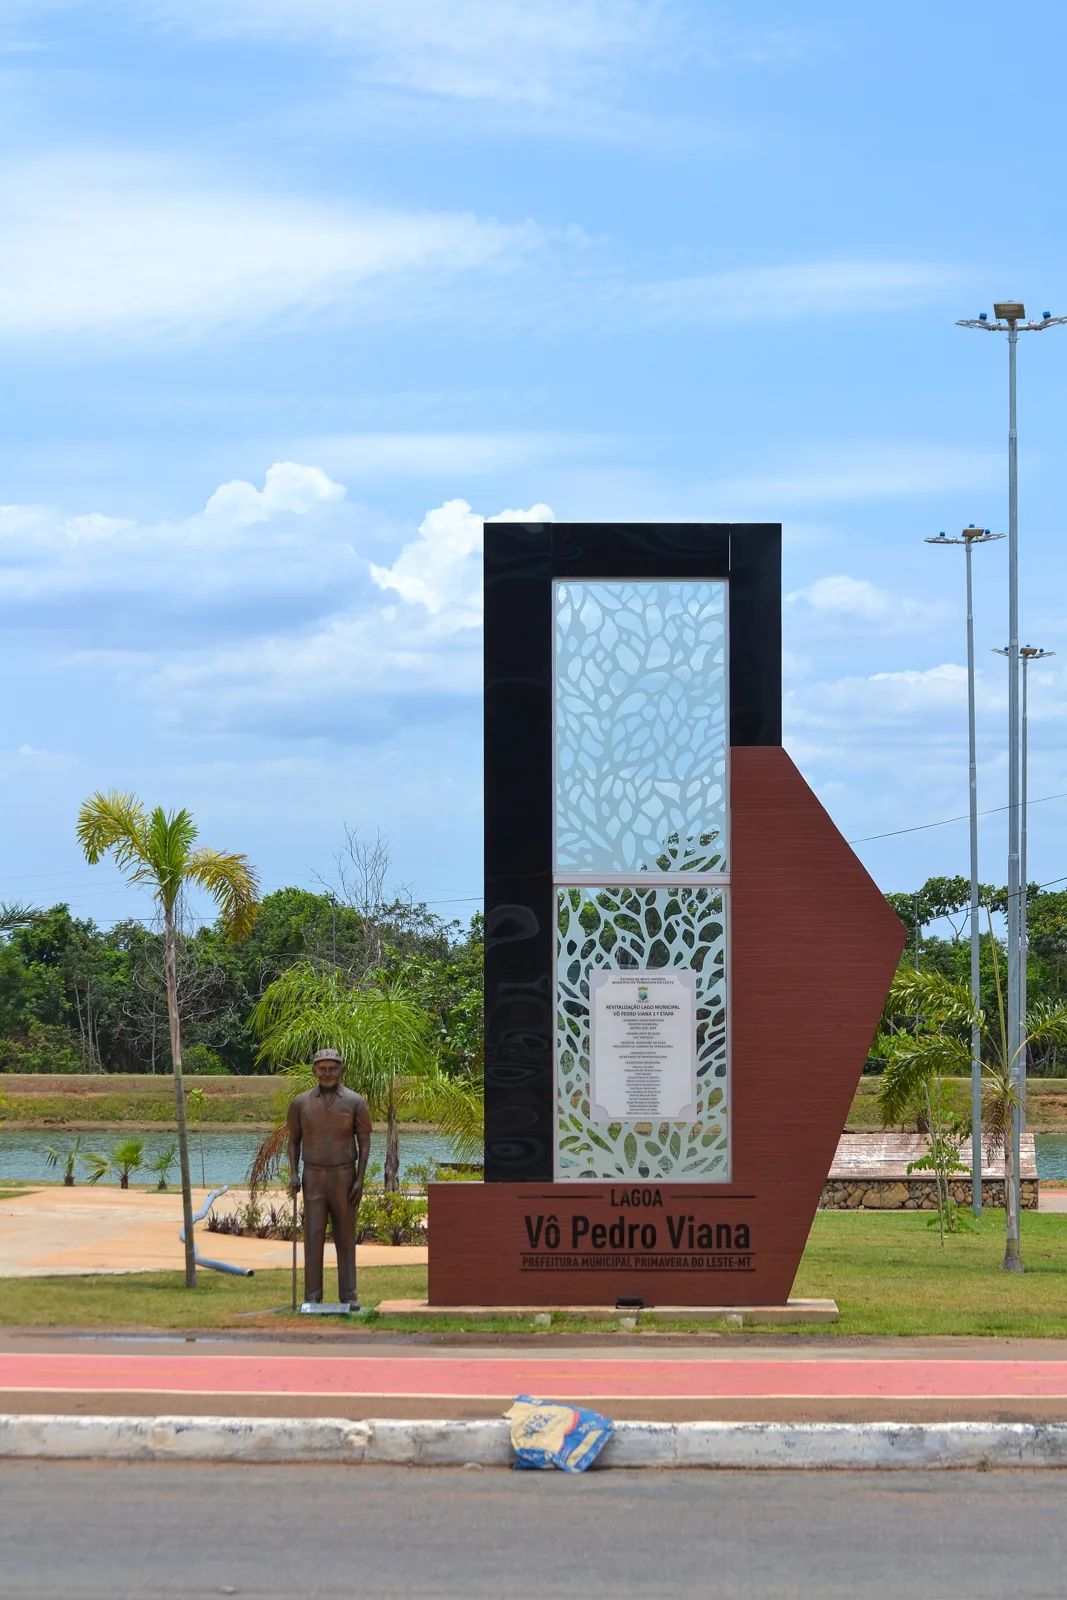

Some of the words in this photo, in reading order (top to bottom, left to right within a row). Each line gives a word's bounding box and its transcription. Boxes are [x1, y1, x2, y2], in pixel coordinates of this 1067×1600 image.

[611, 1189, 663, 1207] LAGOA
[524, 1214, 561, 1249] Vô
[571, 1215, 657, 1249] Pedro
[666, 1215, 750, 1249] Viana
[522, 1256, 579, 1268] PREFEITURA
[581, 1256, 632, 1268] MUNICIPAL
[634, 1256, 689, 1268] PRIMAVERA
[691, 1256, 705, 1267] DO
[707, 1256, 752, 1268] LESTE-MT
